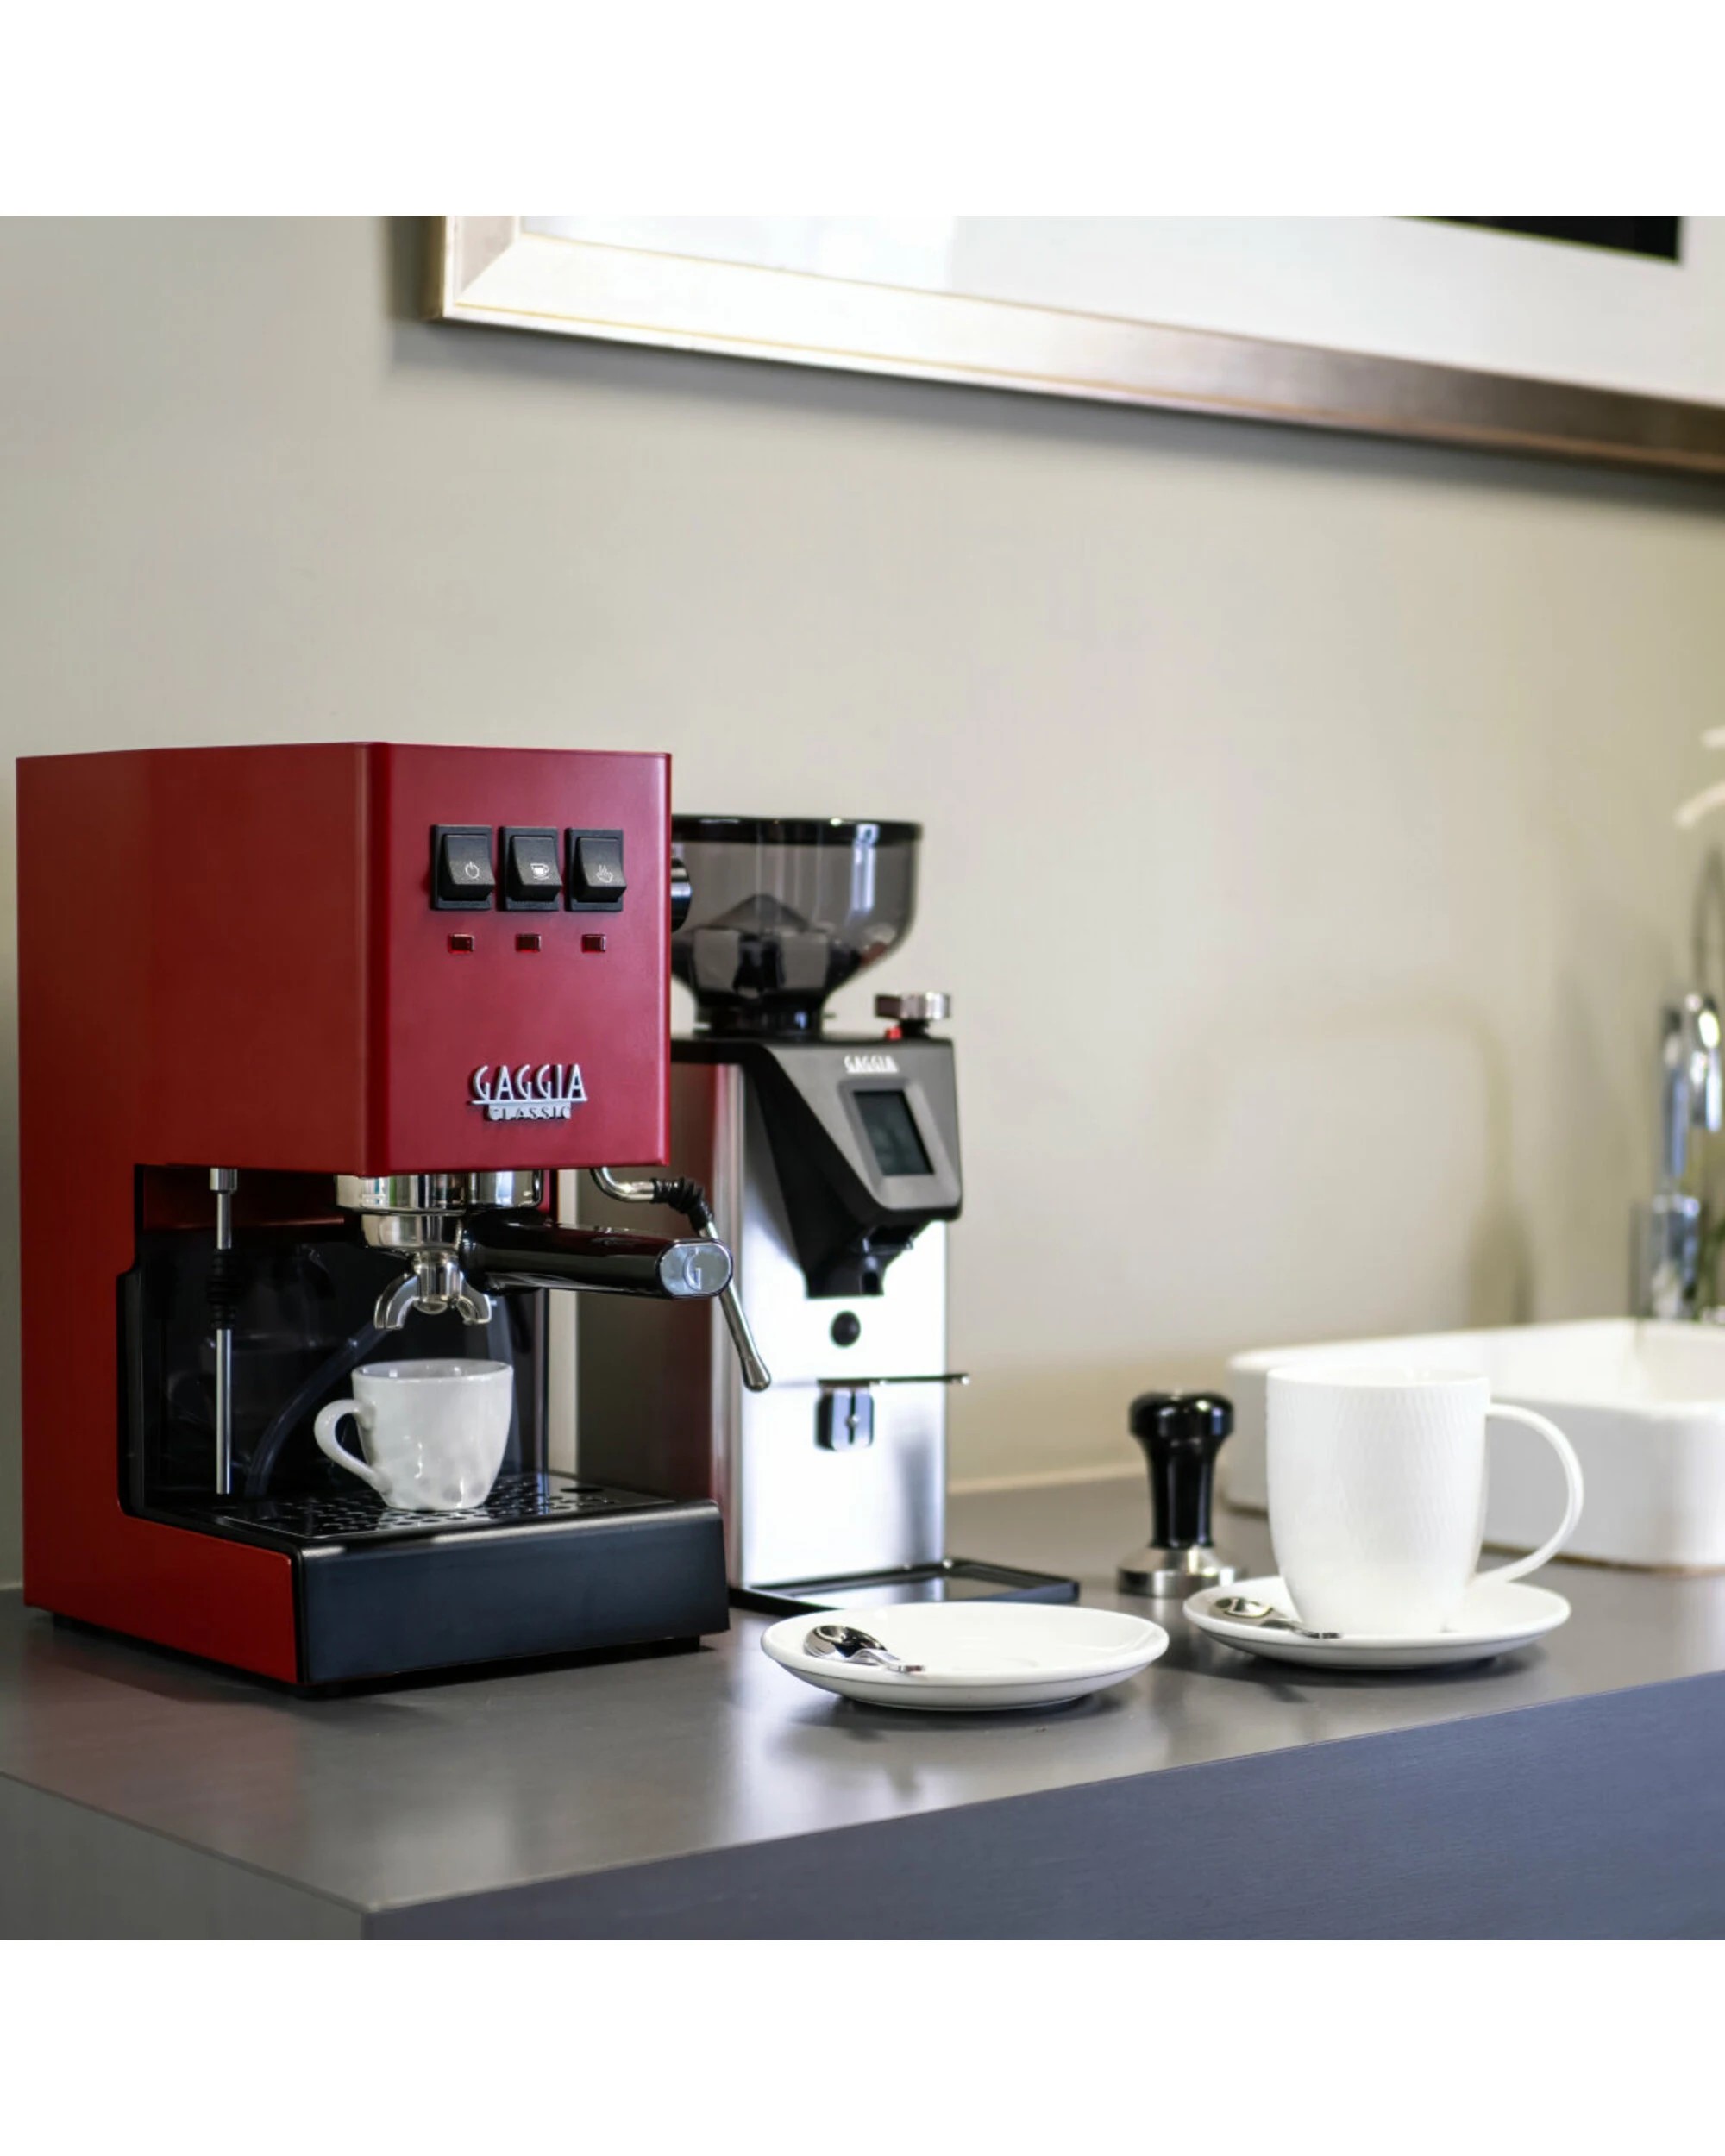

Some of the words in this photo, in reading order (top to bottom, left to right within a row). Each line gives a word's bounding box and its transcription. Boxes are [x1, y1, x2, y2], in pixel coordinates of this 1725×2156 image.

[844, 1054, 899, 1074] GAGGIA
[473, 1063, 586, 1102] GAGGIA
[489, 1106, 571, 1120] CLASSIC
